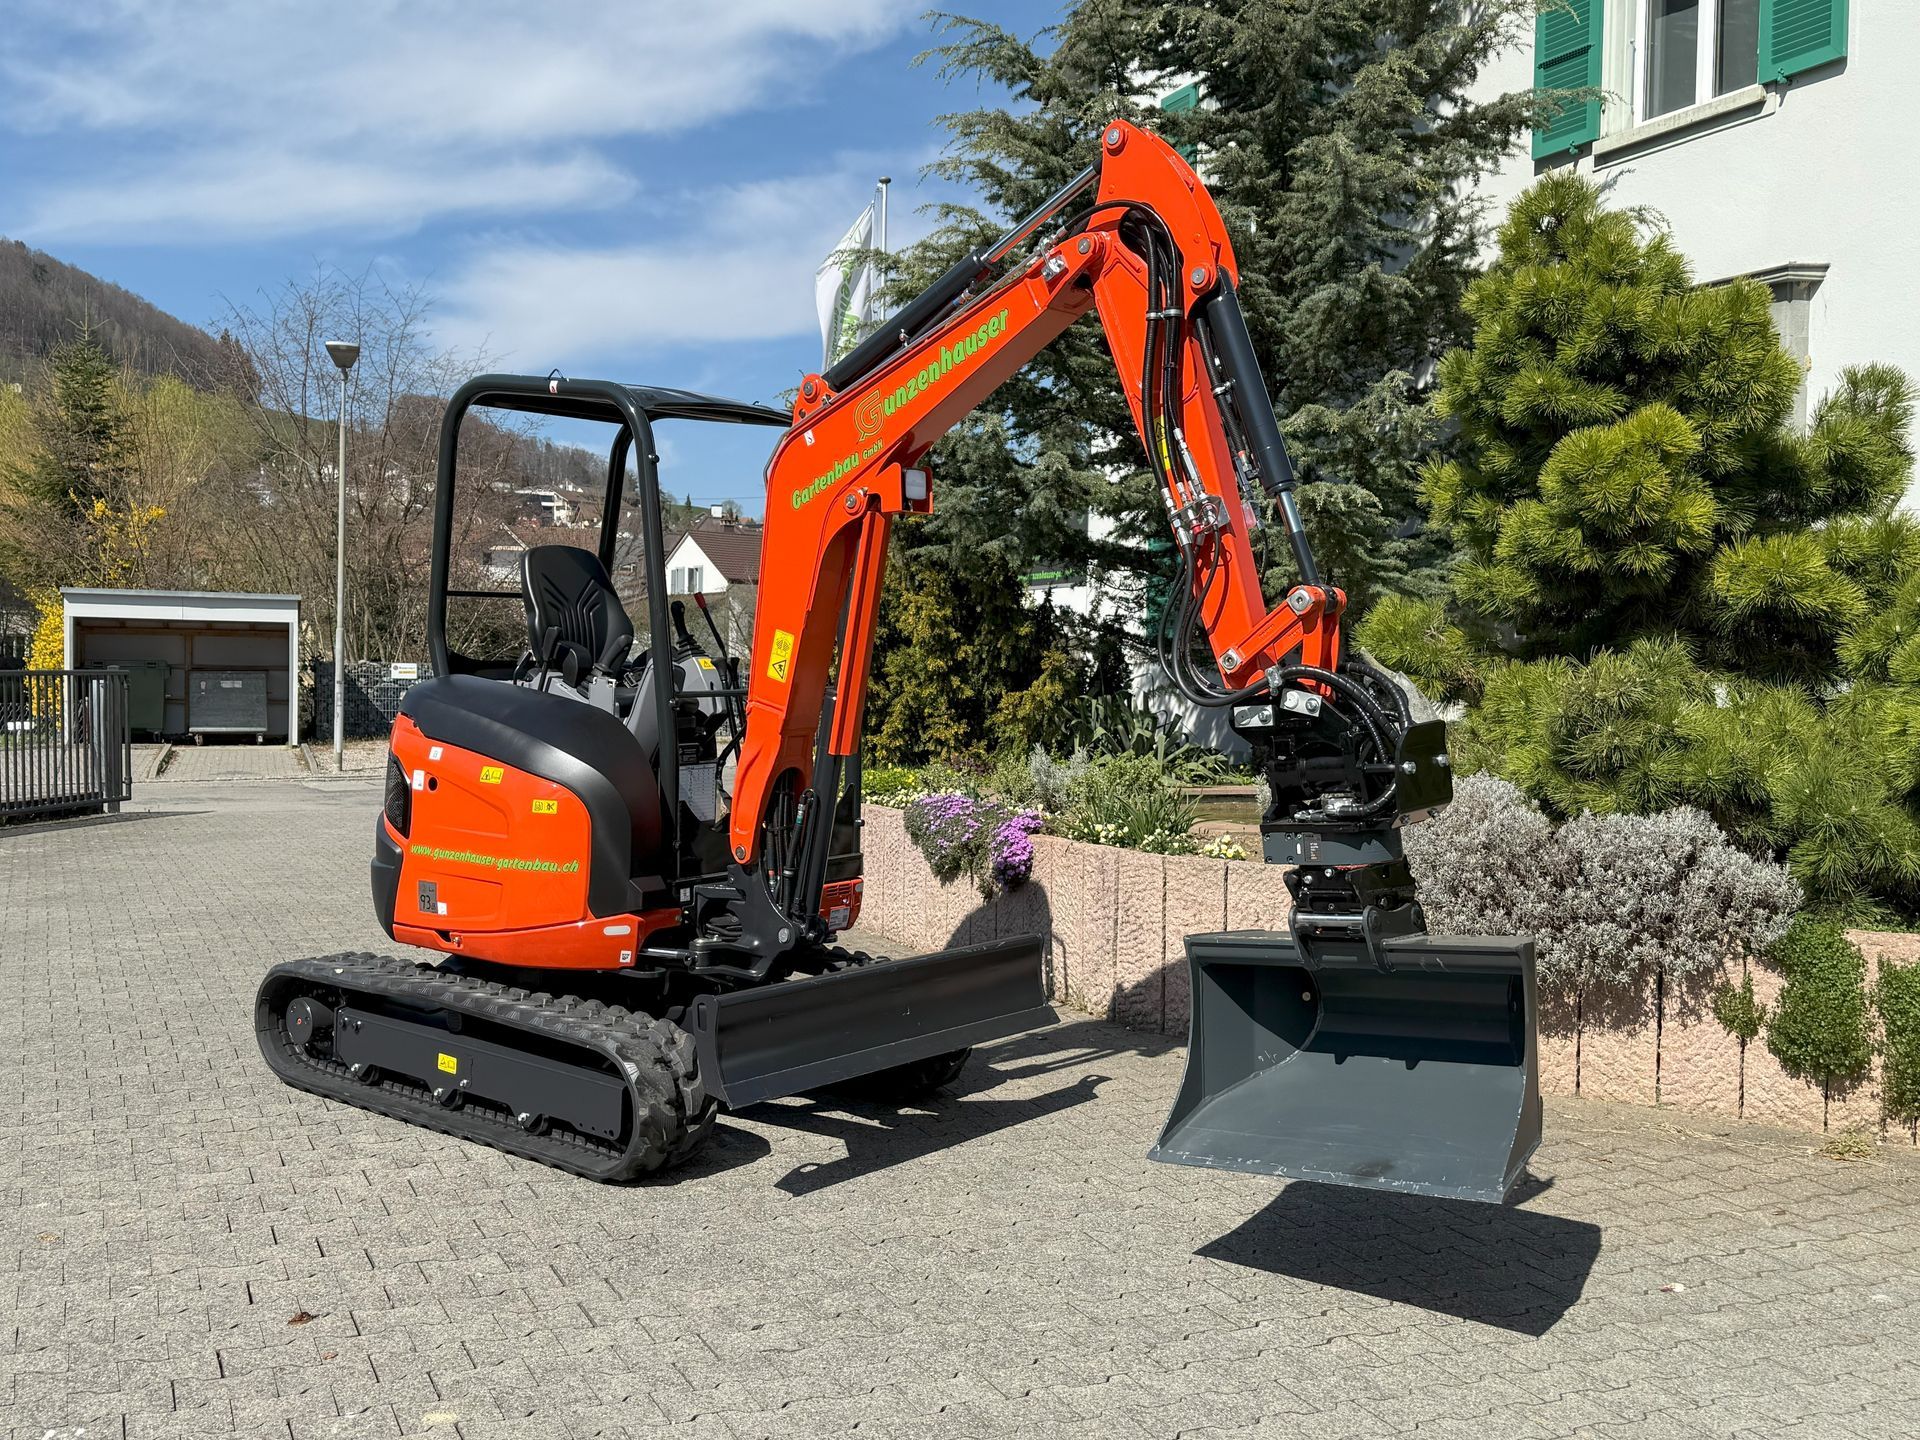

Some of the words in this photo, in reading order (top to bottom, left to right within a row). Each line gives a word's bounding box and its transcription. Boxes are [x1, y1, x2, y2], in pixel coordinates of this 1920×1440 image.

[853, 308, 1009, 442] Gunzenhauser
[792, 452, 860, 509] Gartenbau
[862, 438, 884, 460] GmbH
[411, 844, 579, 873] www.gunzenhauser-gartenbau.ch
[420, 894, 431, 910] 93
